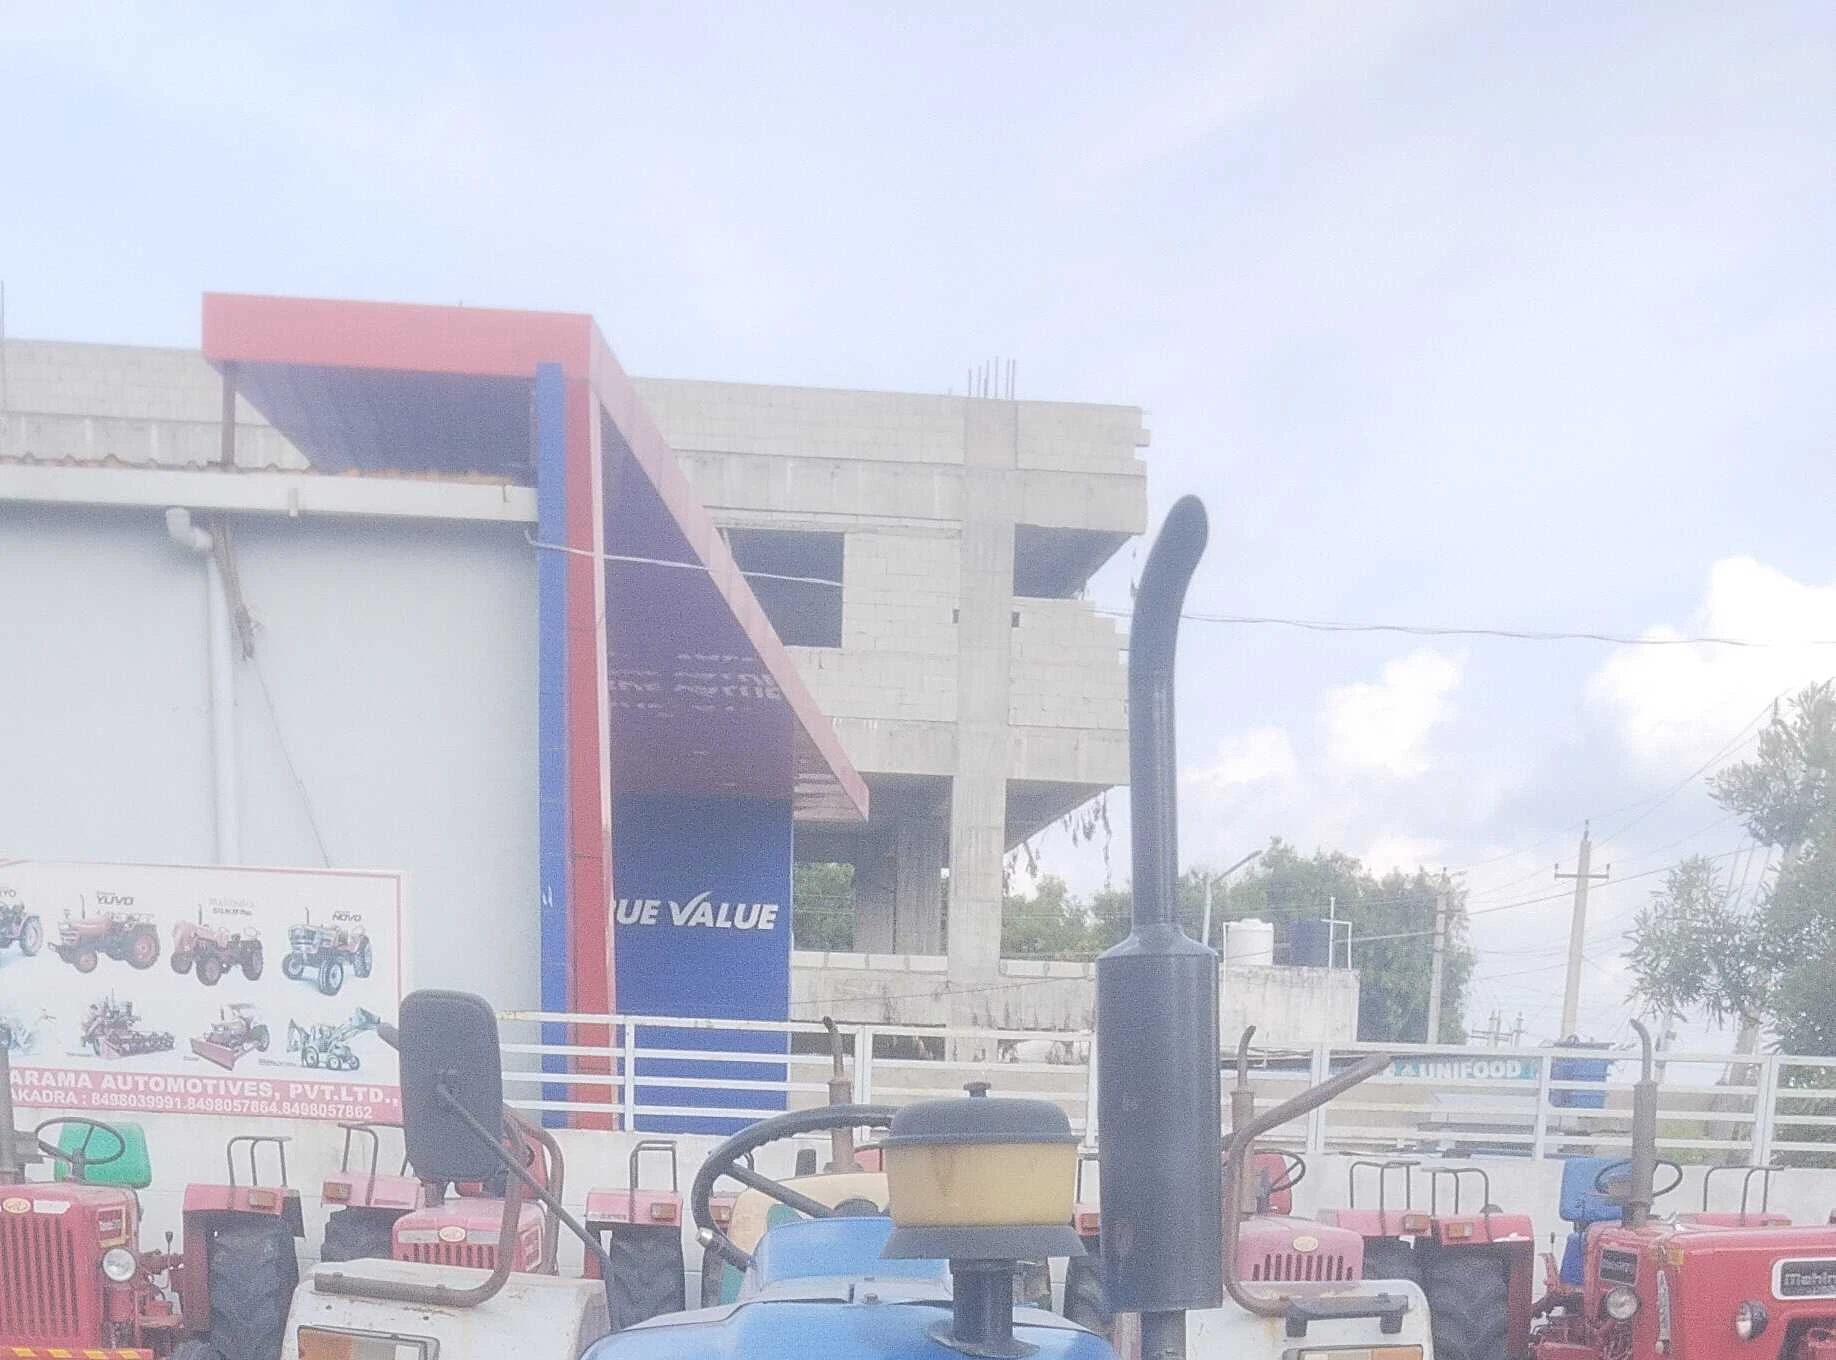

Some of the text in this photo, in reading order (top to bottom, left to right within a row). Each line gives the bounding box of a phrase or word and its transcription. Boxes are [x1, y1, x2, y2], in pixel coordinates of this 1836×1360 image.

[612, 890, 779, 930] UE VALUE
[1421, 1060, 1521, 1079] UNIFOOD
[101, 1073, 281, 1100] AUTOMOTIVES,
